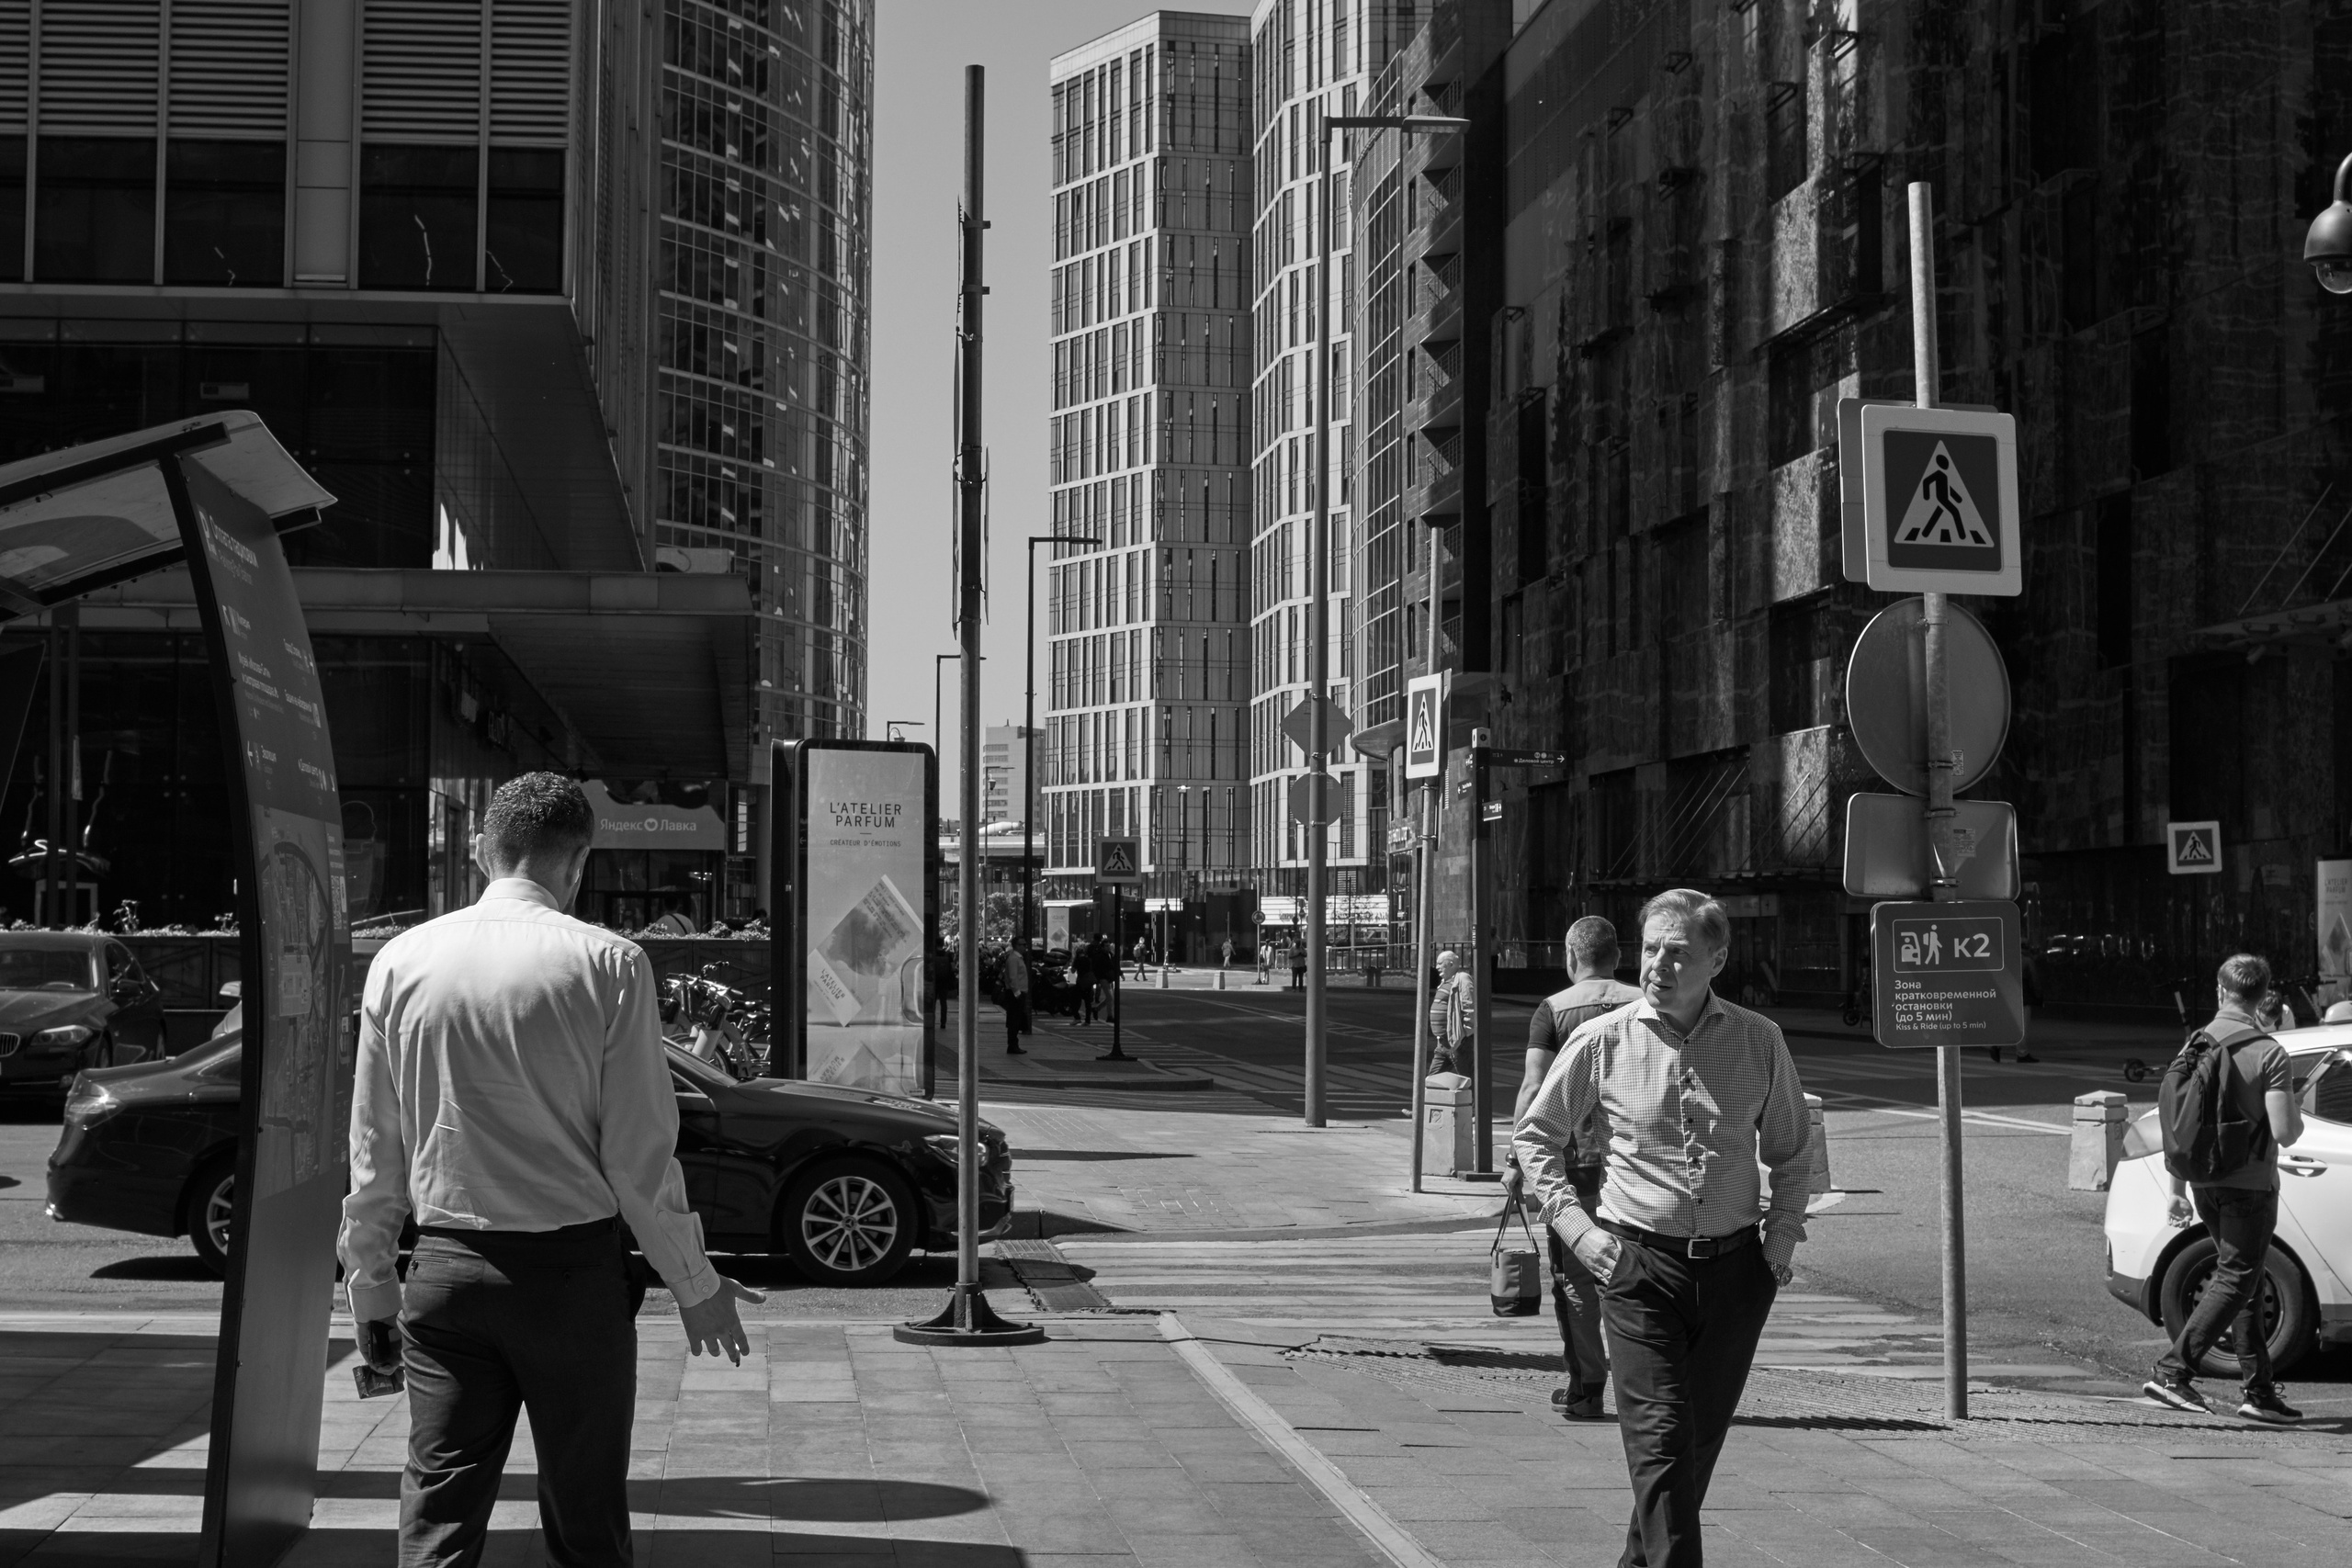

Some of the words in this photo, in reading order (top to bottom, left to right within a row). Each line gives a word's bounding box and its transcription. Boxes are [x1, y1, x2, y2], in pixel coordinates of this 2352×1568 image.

[830, 802, 901, 816] L'ATELIER
[600, 818, 643, 832] Яндекс
[660, 818, 697, 831] Лавка
[835, 815, 895, 828] PARFUM
[820, 975, 841, 1000] PARFUM
[1894, 979, 1922, 989] Зона
[1894, 988, 1996, 1002] кратковременной
[1895, 1002, 1953, 1011] остановки
[1895, 1011, 1914, 1022] (до
[1917, 1011, 1923, 1021] 5
[1926, 1010, 1952, 1021] мин)
[1895, 1022, 1911, 1031] Kiss
[1920, 1021, 1938, 1030] Ride
[1939, 1021, 1951, 1031] (up
[1969, 1021, 1986, 1030] min)
